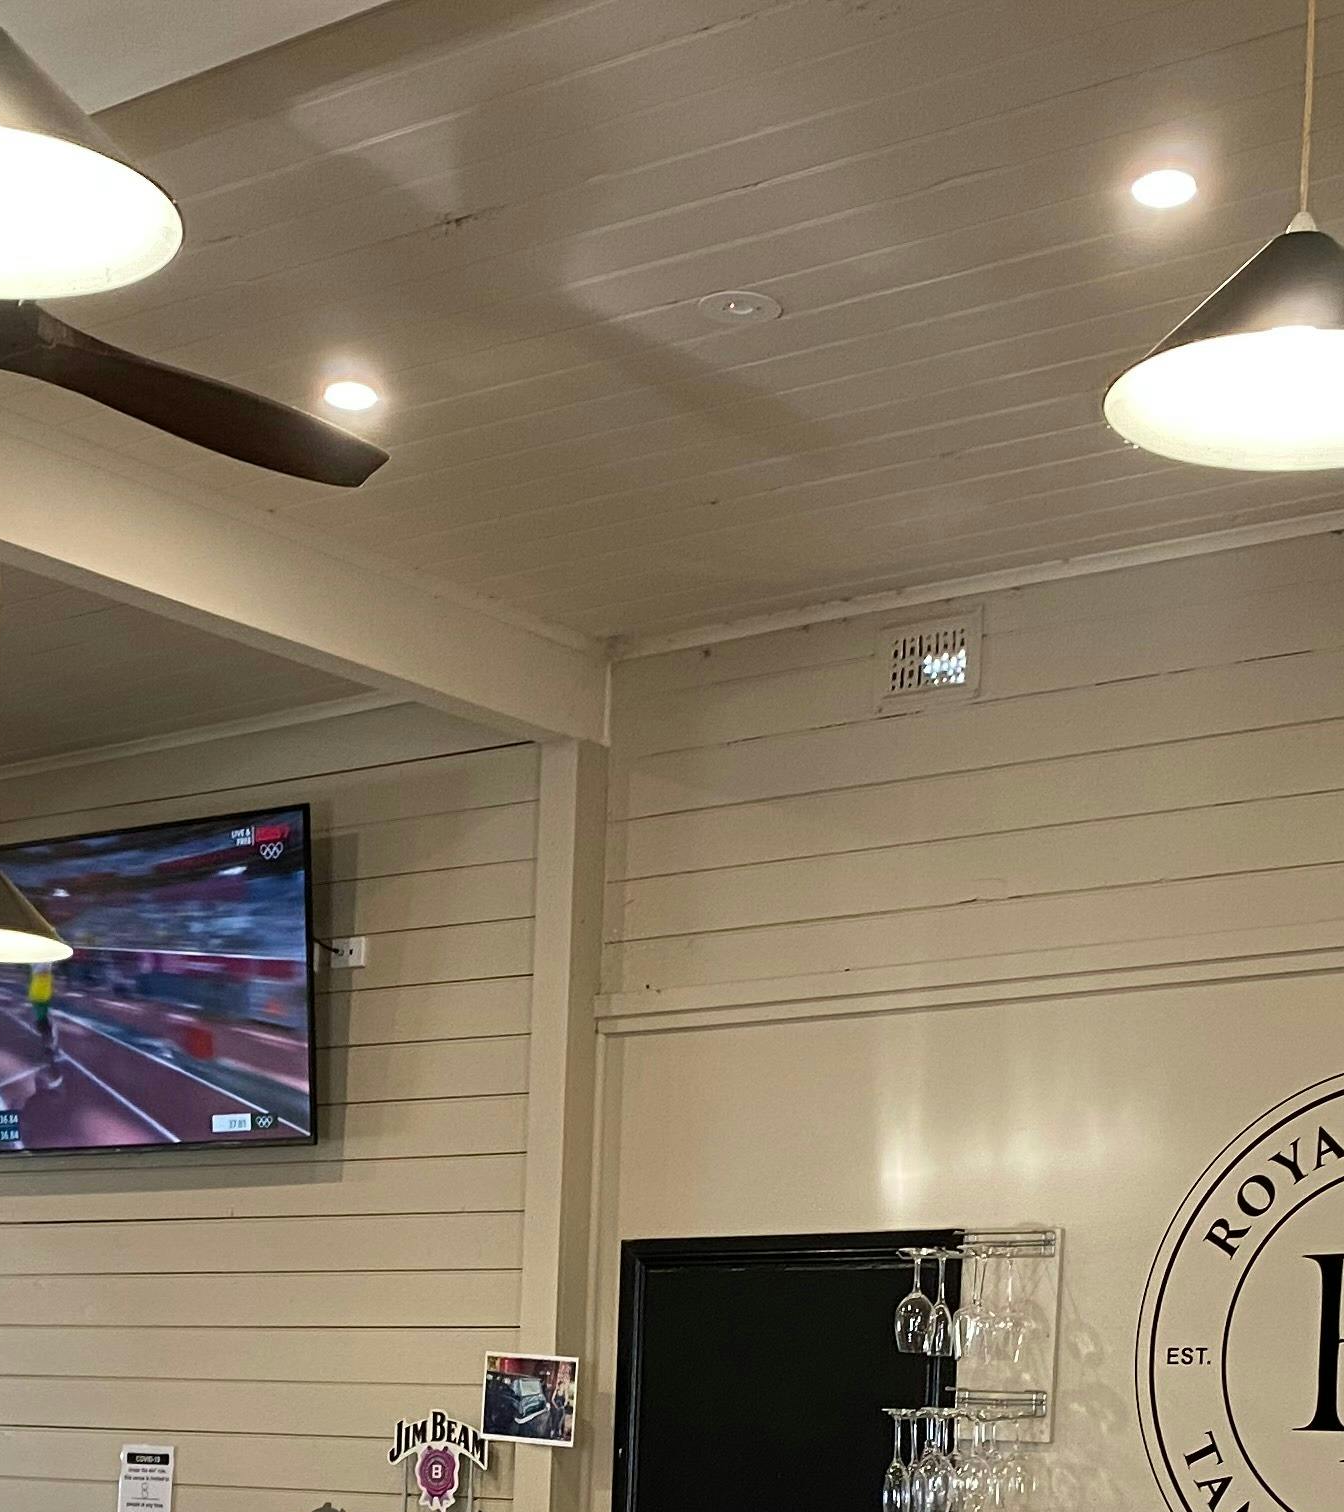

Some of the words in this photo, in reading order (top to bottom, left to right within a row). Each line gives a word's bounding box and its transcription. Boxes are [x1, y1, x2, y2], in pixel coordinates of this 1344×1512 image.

[1166, 1347, 1212, 1365] EST.
[389, 1419, 427, 1463] JIM
[431, 1411, 488, 1466] BEAM
